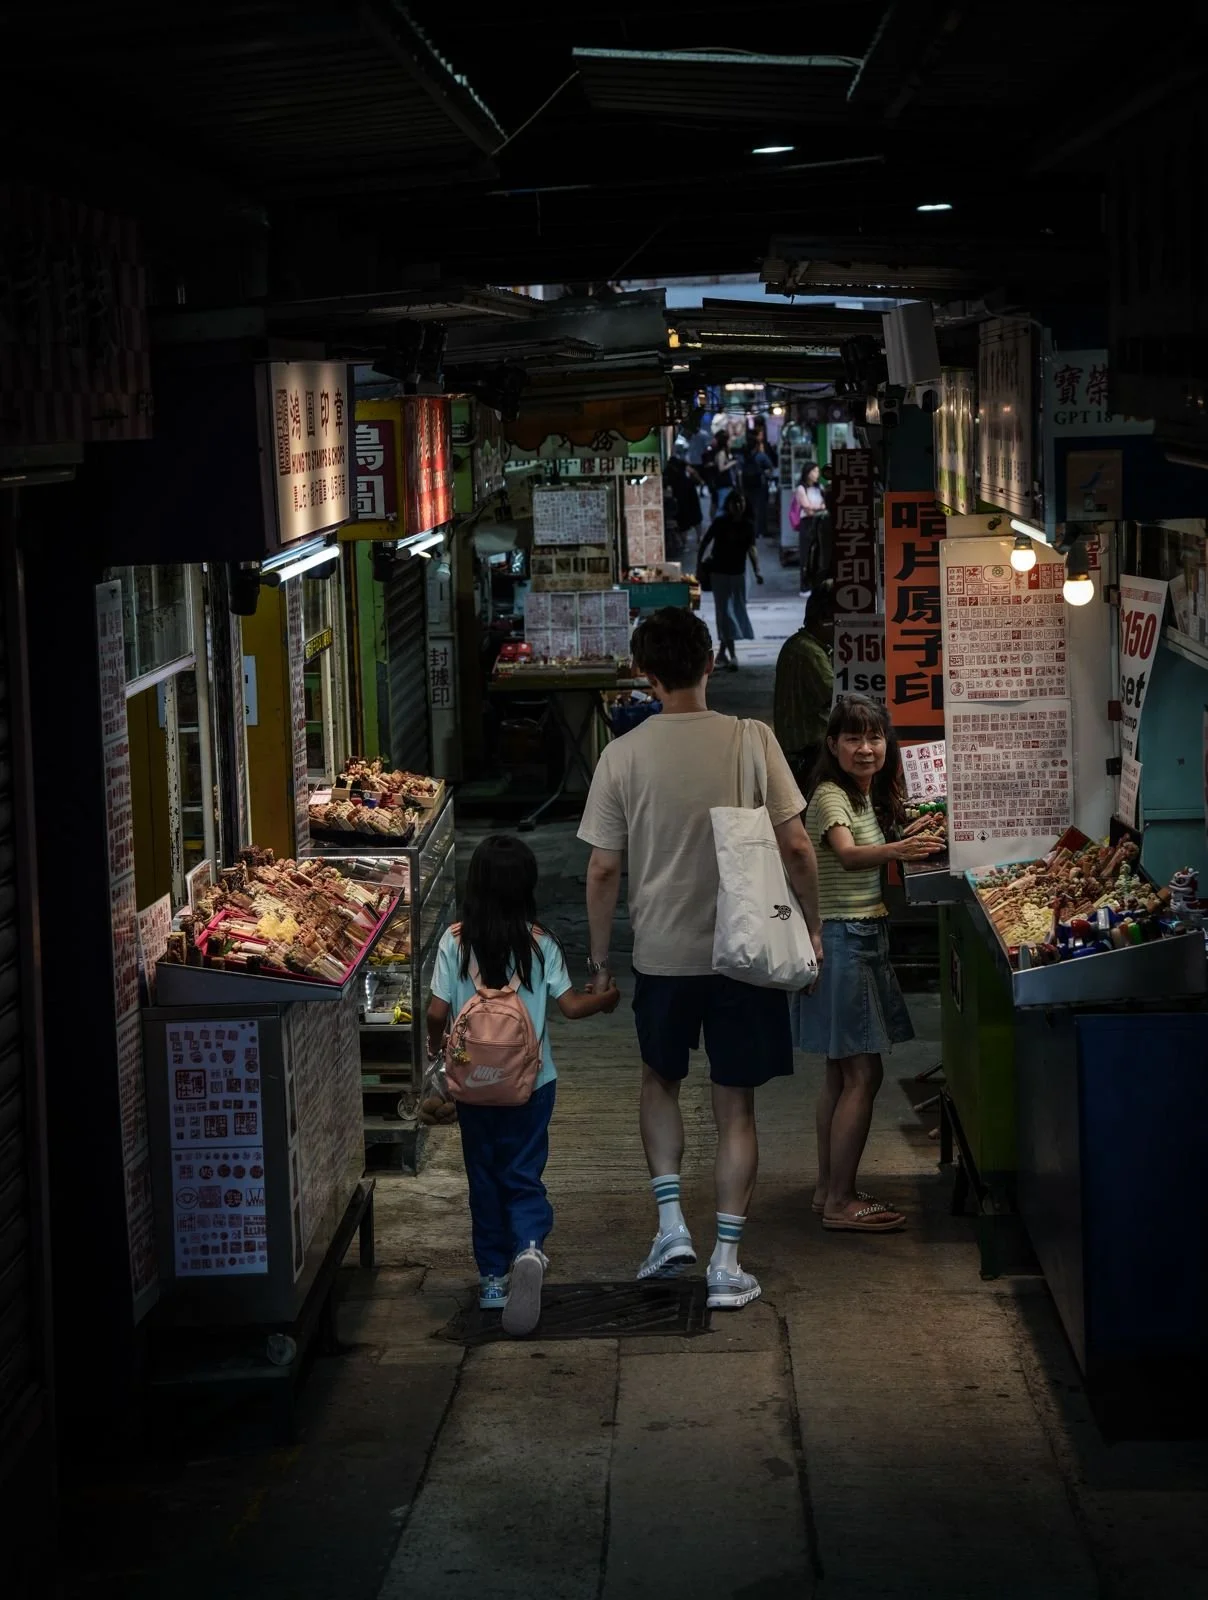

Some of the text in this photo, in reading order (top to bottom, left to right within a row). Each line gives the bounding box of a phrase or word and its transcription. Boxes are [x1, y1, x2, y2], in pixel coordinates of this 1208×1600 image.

[1054, 411, 1090, 425] GPT
[854, 673, 886, 691] se
[472, 1065, 505, 1081] NIKE
